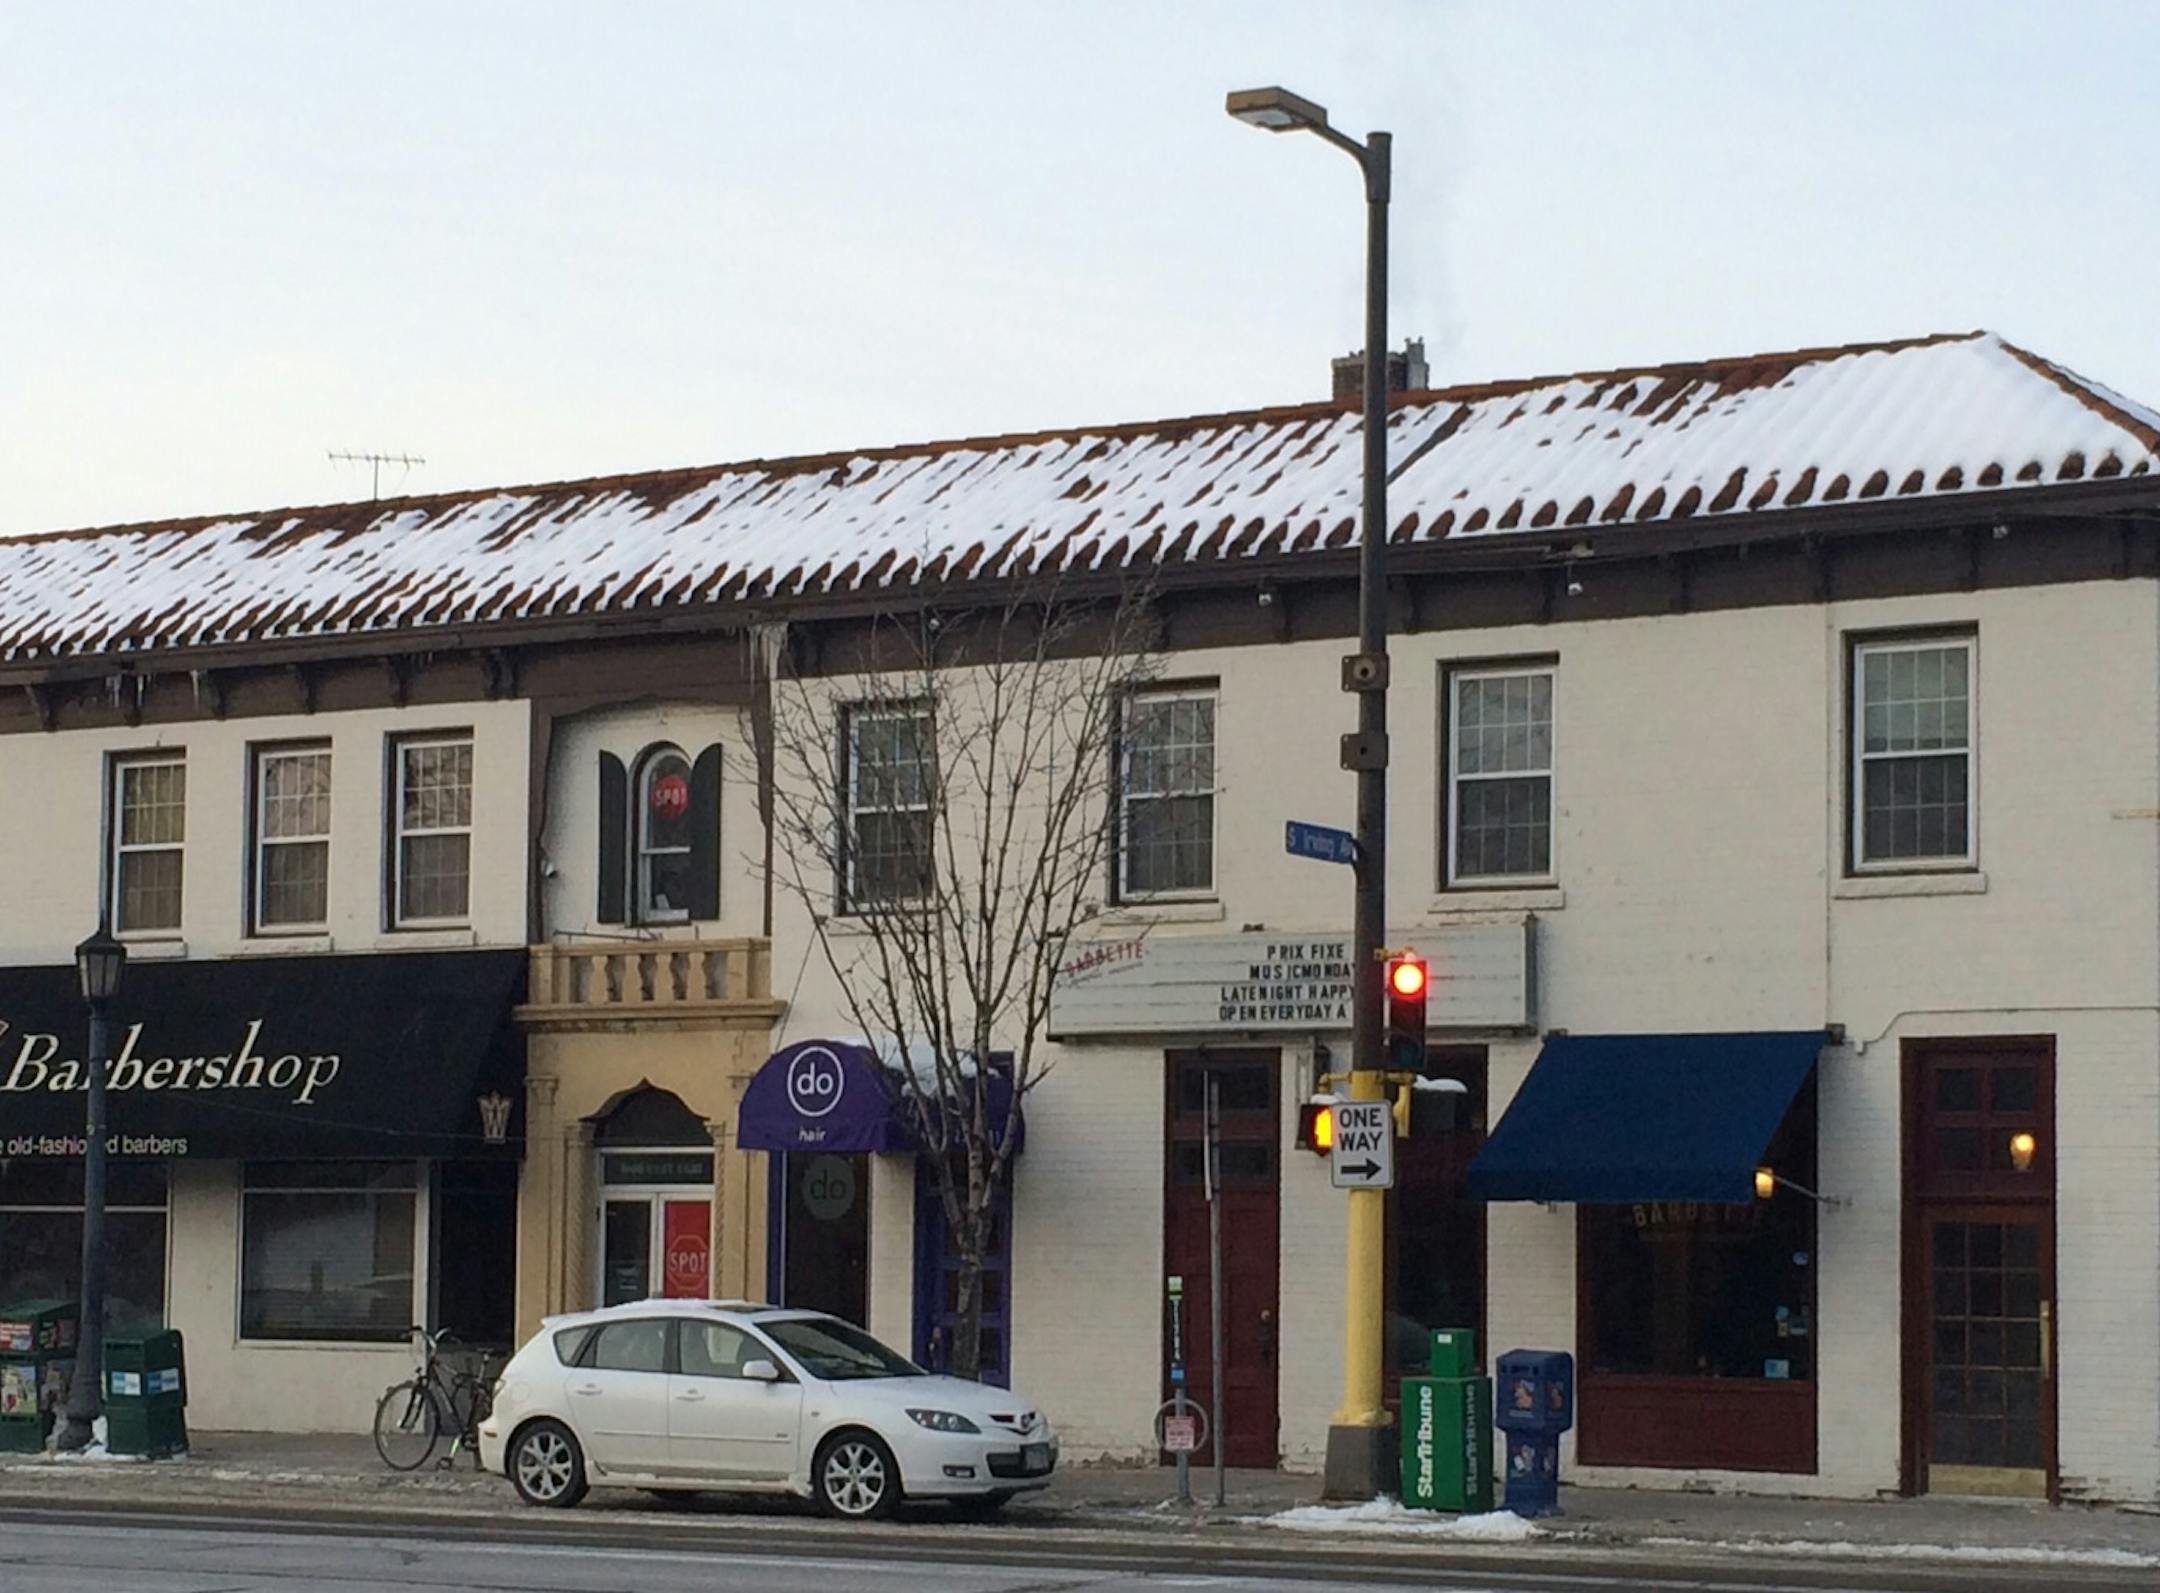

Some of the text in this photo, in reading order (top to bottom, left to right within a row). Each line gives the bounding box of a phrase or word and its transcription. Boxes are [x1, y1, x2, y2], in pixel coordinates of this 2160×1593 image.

[1267, 943, 1345, 960] PRIX FIXE
[797, 1062, 834, 1096] do
[1339, 1108, 1382, 1128] ONE
[799, 1126, 827, 1142] hair
[1339, 1131, 1383, 1151] WAY
[7, 1134, 118, 1155] old-fashiod
[122, 1134, 188, 1155] barbers
[670, 1252, 708, 1272] SPOT
